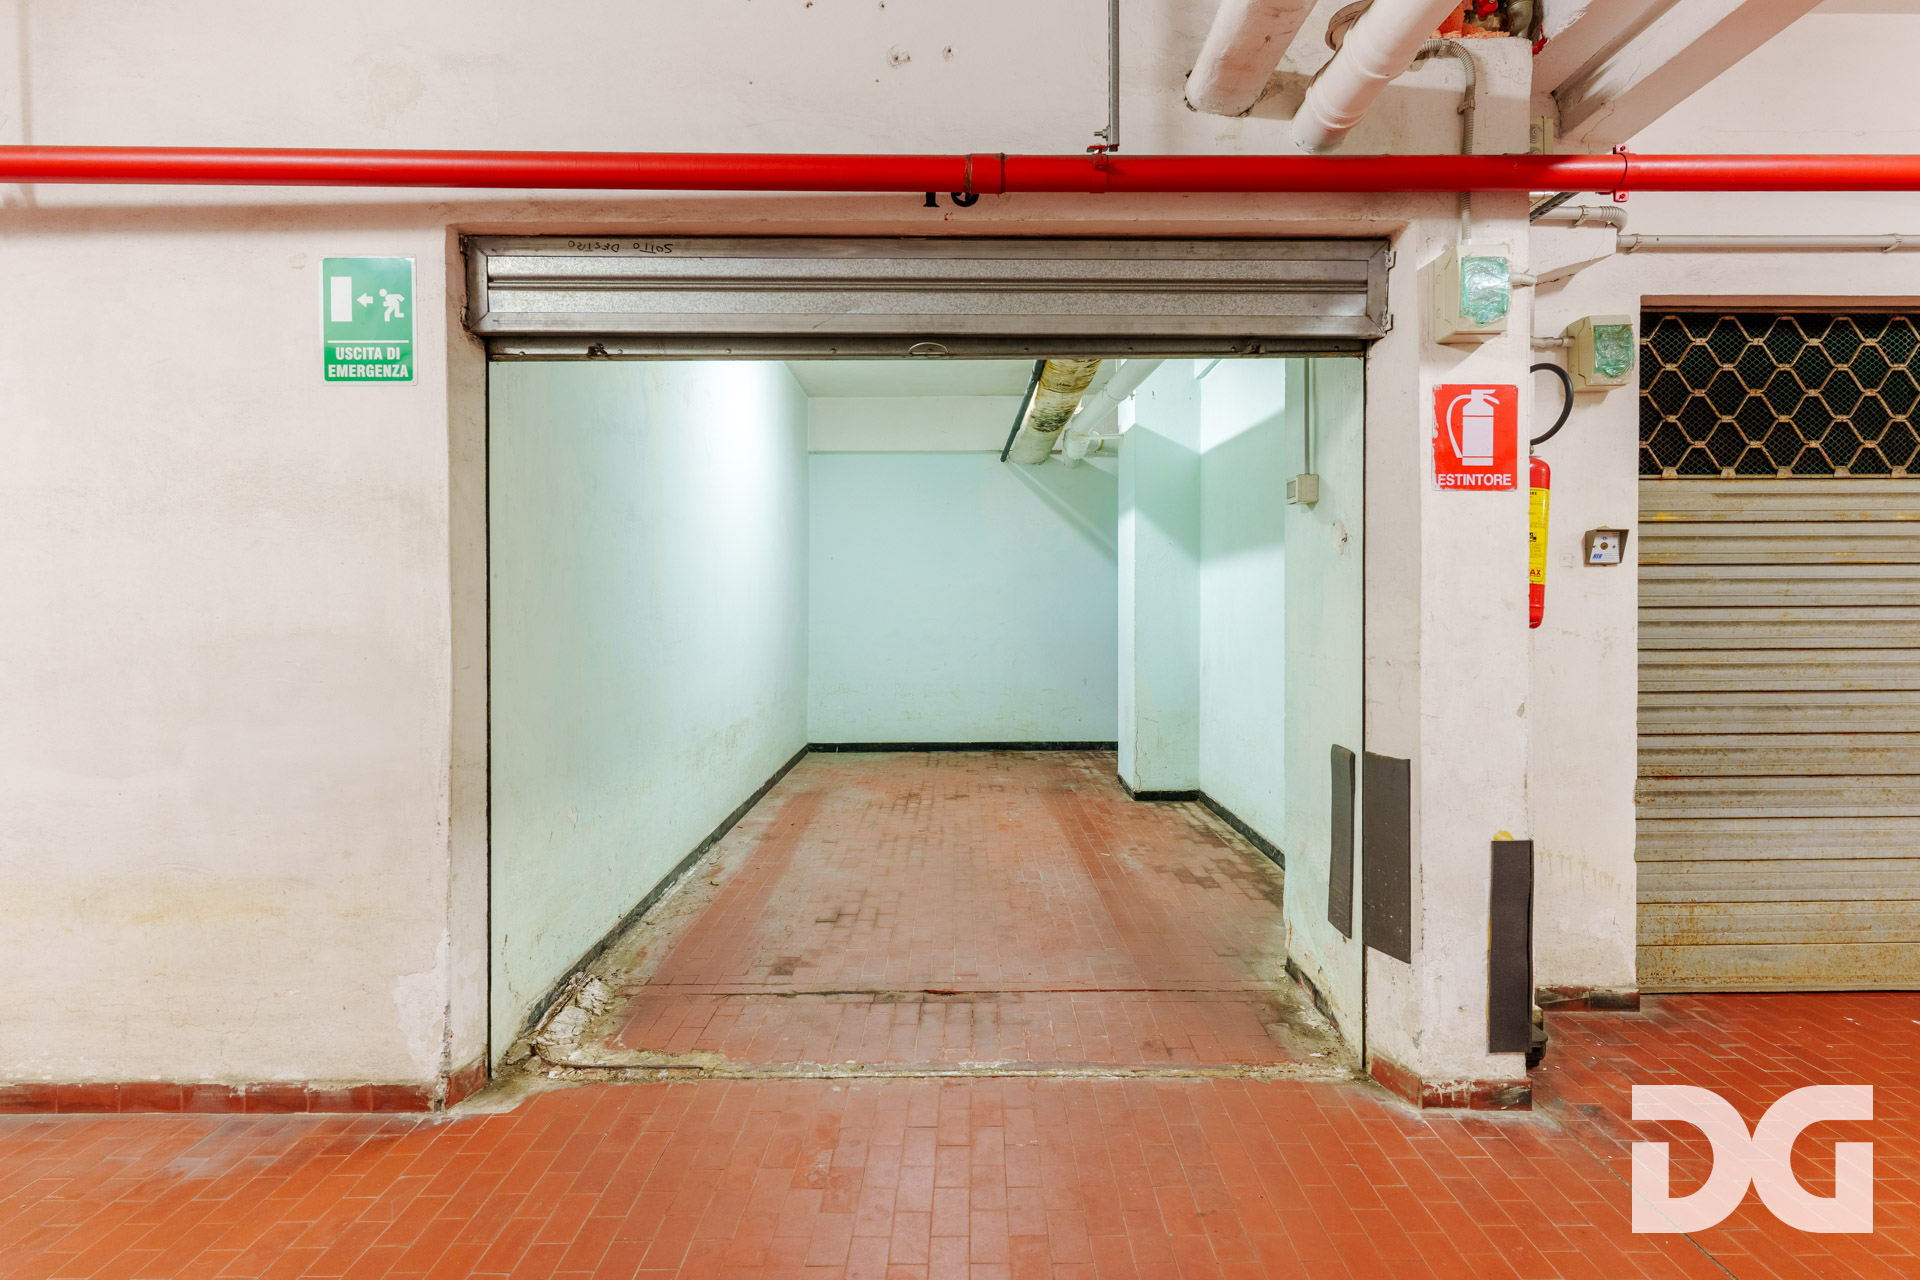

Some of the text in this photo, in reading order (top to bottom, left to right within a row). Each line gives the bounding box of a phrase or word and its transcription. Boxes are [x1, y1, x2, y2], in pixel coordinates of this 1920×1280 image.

[567, 240, 674, 254] SOTTO DESTRO
[335, 347, 401, 360] USCITA DI
[328, 364, 409, 378] EMERGENZA
[1437, 473, 1512, 486] ESTINTORE
